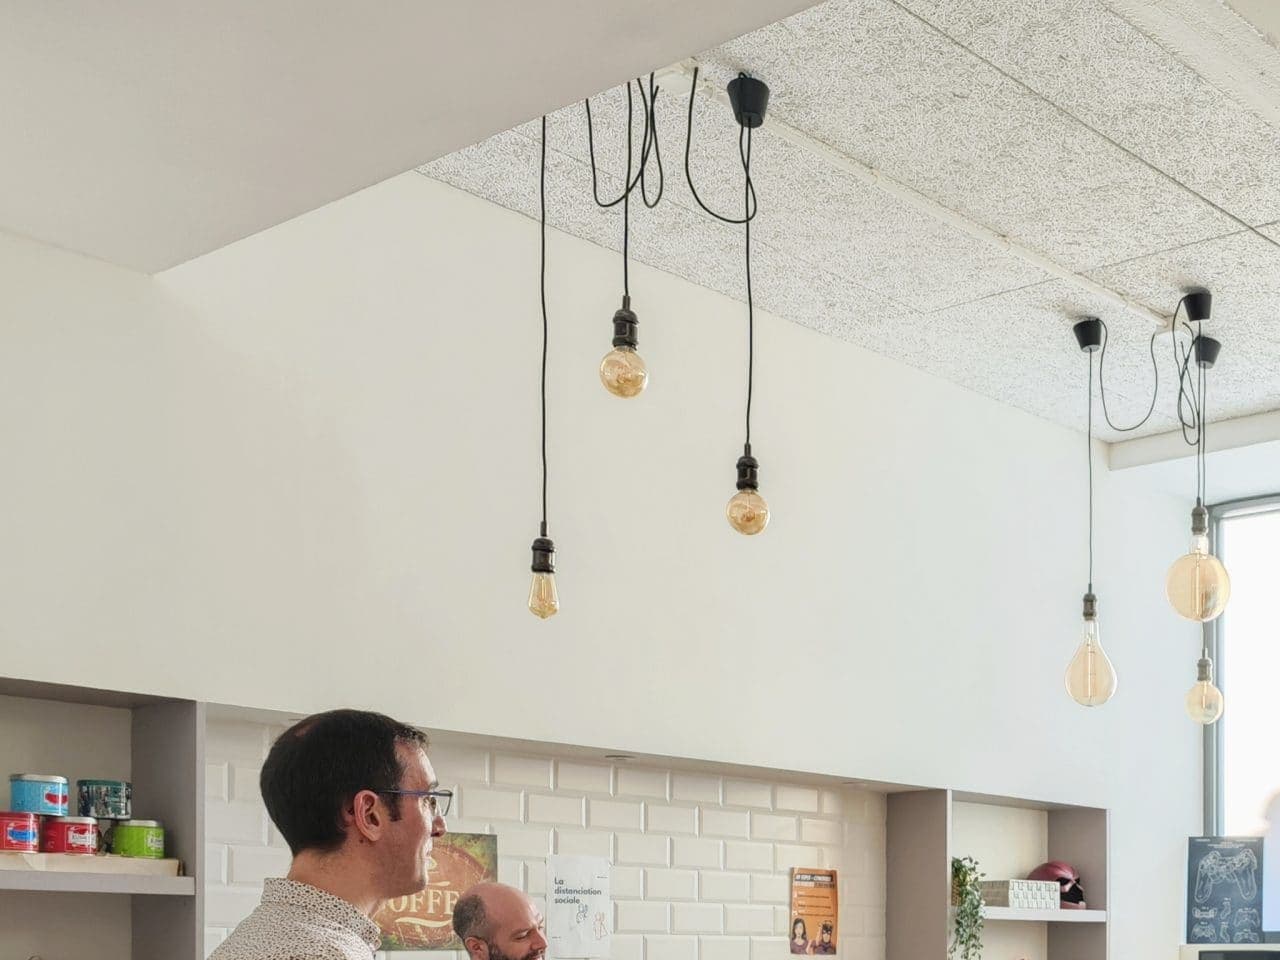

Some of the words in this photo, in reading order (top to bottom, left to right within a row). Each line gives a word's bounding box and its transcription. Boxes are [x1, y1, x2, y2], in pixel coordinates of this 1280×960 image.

[554, 877, 564, 885] La
[554, 886, 602, 896] distanciation
[554, 896, 581, 904] sociale
